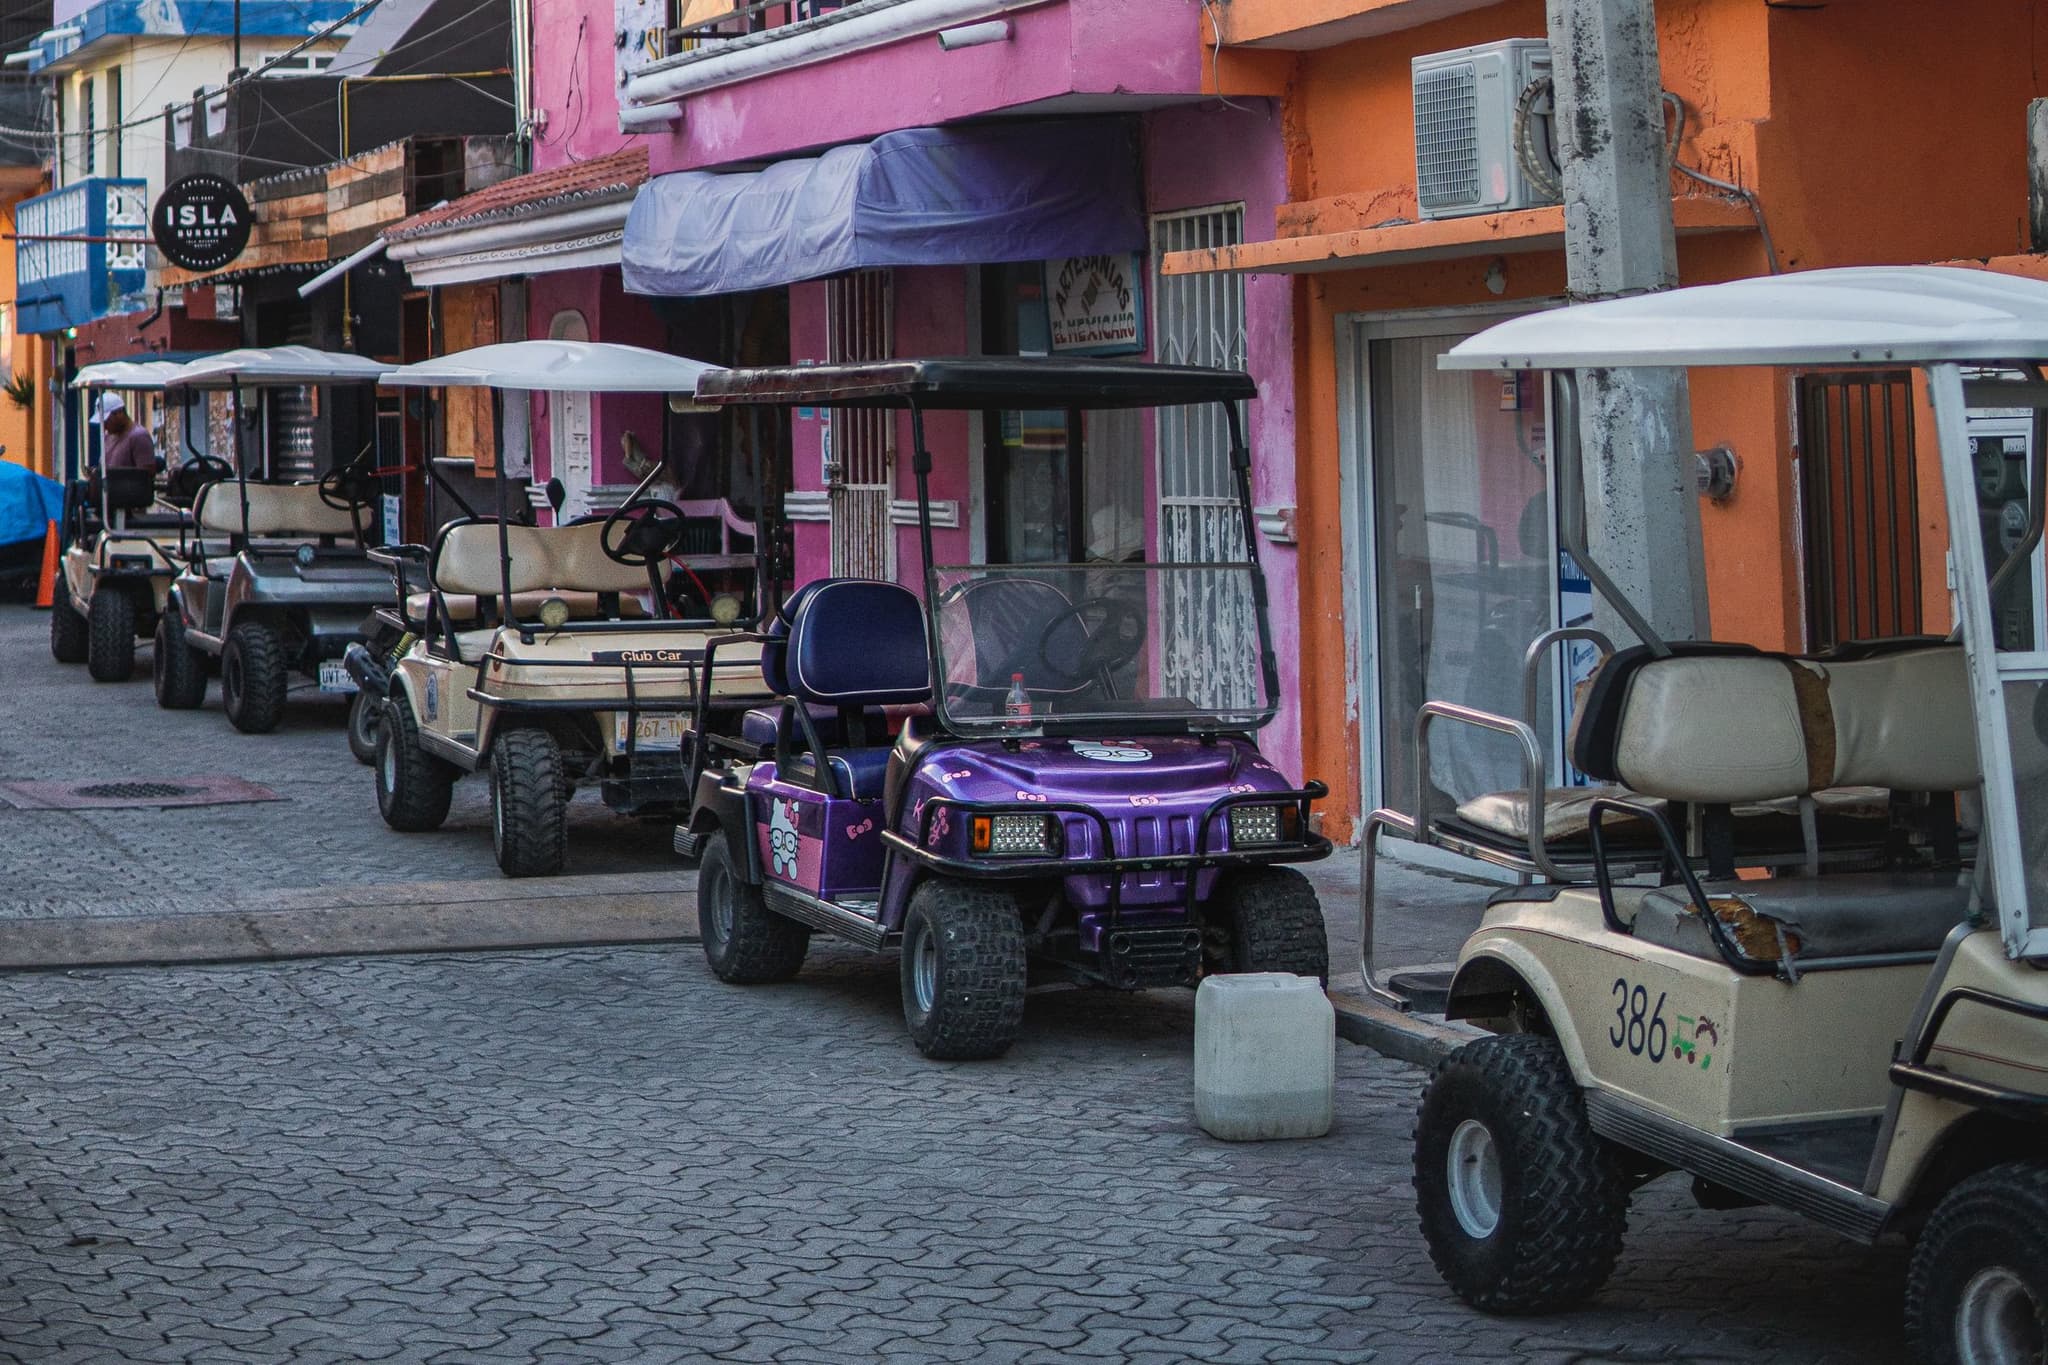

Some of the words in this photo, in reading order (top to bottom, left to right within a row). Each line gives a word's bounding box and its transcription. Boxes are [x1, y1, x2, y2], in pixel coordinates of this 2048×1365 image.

[167, 204, 237, 226] ISLA
[177, 228, 228, 239] BURGER
[1056, 254, 1130, 317] ARTESANIAS
[1067, 312, 1135, 343] MEXICANO
[621, 651, 653, 661] Club
[656, 650, 682, 661] Car
[1609, 978, 1667, 1063] 386
